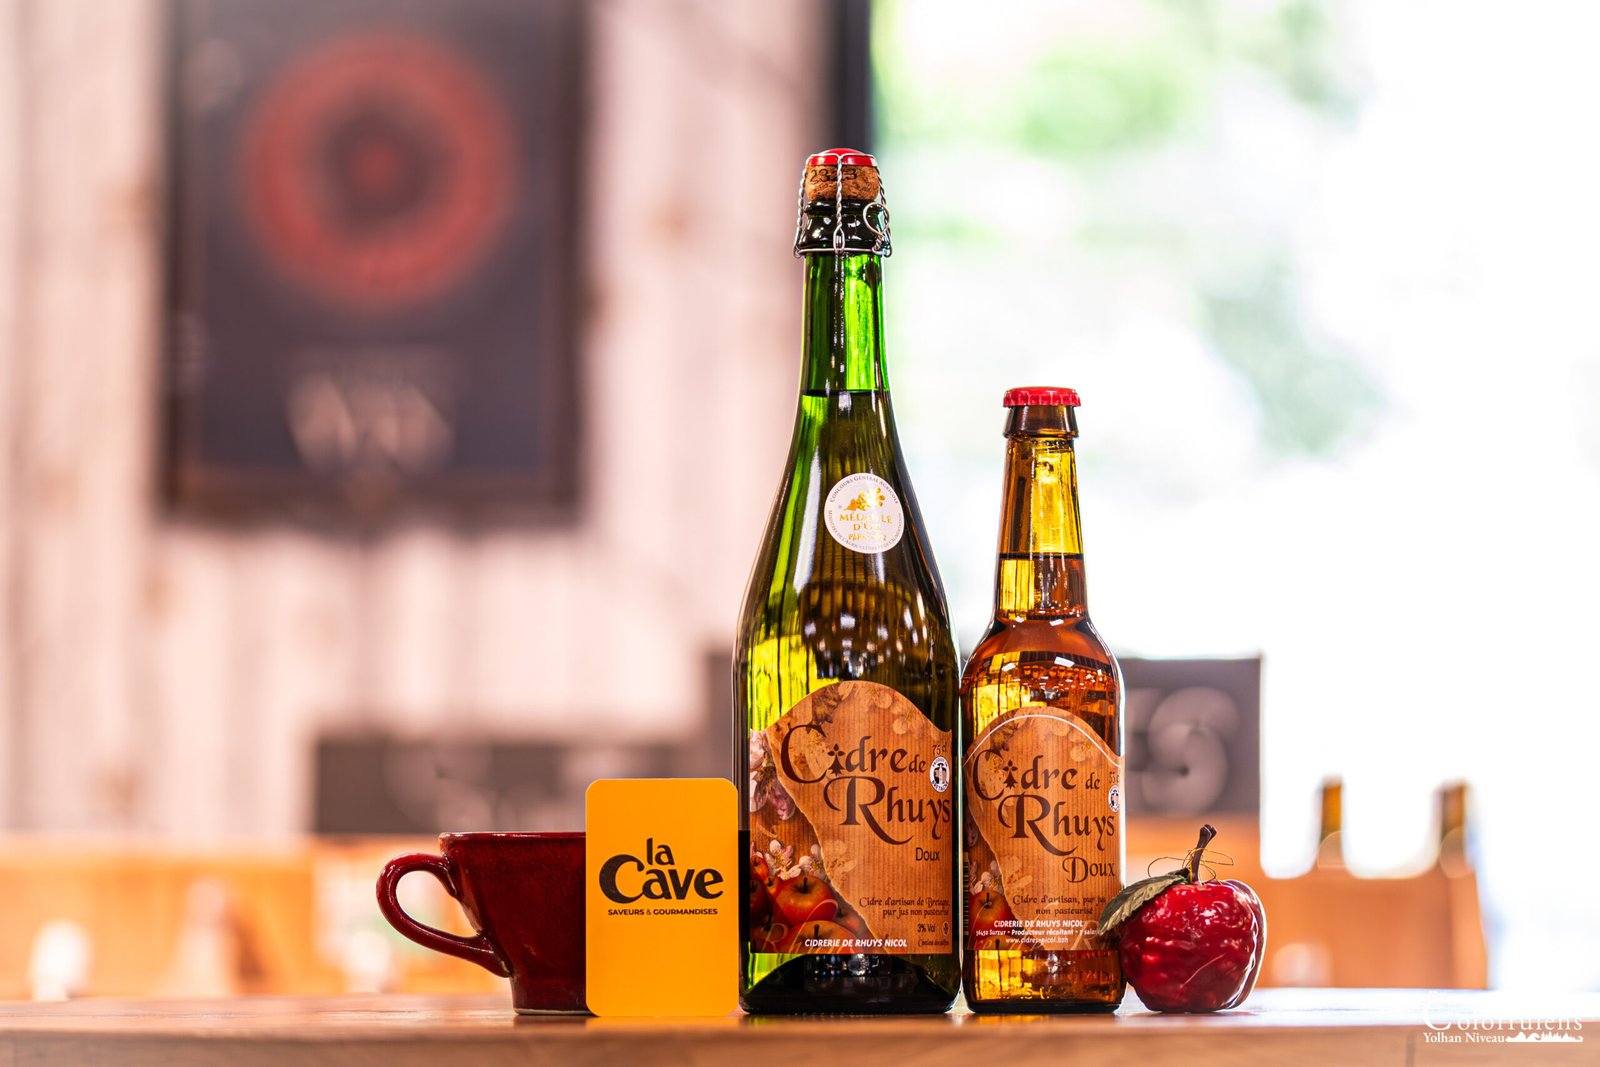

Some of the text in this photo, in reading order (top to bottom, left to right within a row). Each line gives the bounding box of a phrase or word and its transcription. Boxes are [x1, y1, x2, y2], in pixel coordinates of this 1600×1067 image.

[839, 512, 892, 524] MÉDLE
[781, 723, 926, 784] Cidre de
[973, 749, 1077, 801] Cidre
[1085, 772, 1100, 790] de
[823, 775, 951, 845] Rhuys
[998, 791, 1115, 856] Rhuys
[646, 838, 675, 866] la
[915, 848, 940, 861] Doux
[599, 854, 724, 904] Cave
[1062, 857, 1115, 883] Doux
[859, 897, 883, 907] Cidre
[916, 897, 924, 906] de
[1013, 895, 1038, 905] Cidre
[1041, 895, 1080, 904] d'artisan,
[1083, 897, 1095, 905] pur
[883, 910, 896, 920] pur
[897, 908, 909, 919] jus
[917, 924, 936, 933] 3% Vol
[805, 939, 908, 947] CIDRERIE DE RHUYS NICOL
